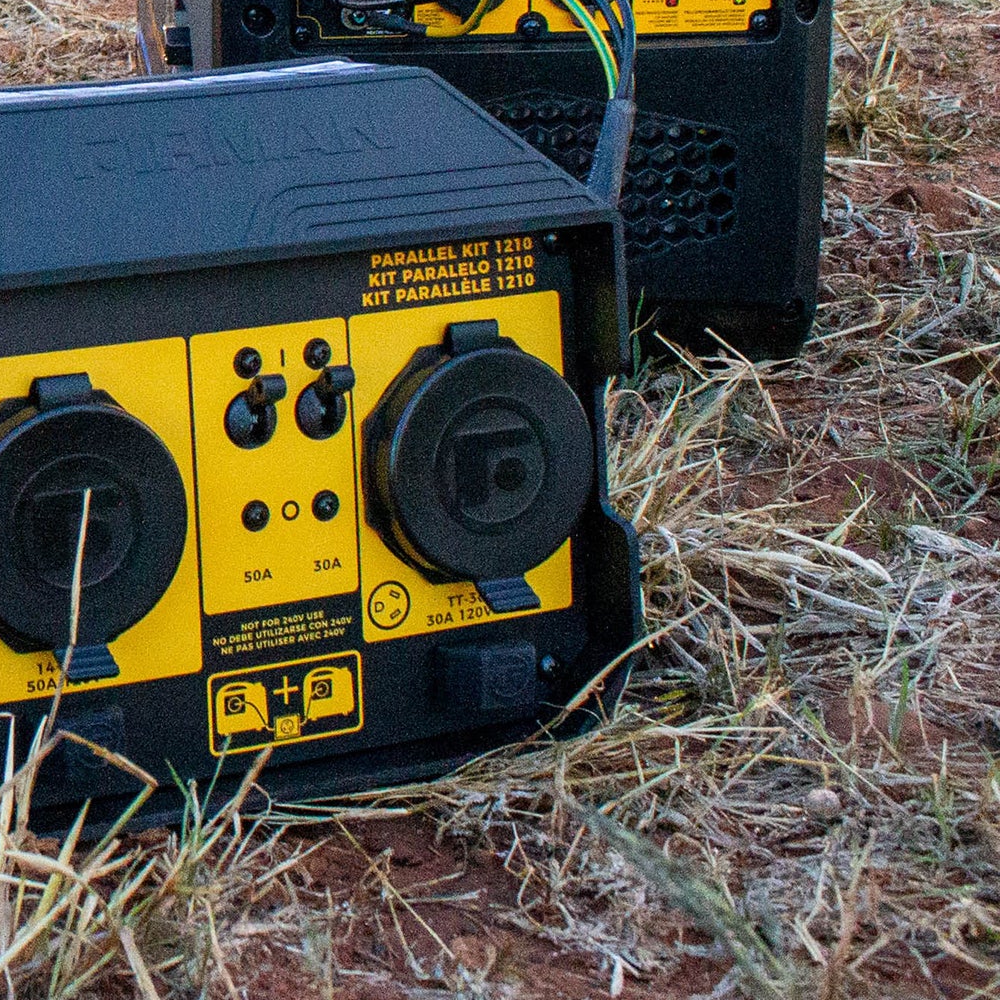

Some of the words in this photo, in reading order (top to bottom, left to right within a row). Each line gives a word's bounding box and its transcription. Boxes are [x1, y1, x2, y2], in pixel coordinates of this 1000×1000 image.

[371, 246, 457, 269] PARALLEL
[462, 241, 489, 258] KIT
[495, 237, 533, 254] 1210
[369, 271, 397, 288] KIT
[402, 260, 490, 284] PARALELO
[496, 255, 534, 272] 1210
[362, 290, 390, 307] KIT
[396, 277, 491, 303] PARALLÈLE
[497, 273, 535, 290] 1210
[244, 568, 273, 583] 50A
[313, 557, 342, 572] 30A
[212, 637, 227, 647] NO
[229, 632, 253, 644] DEBE
[255, 623, 307, 639] UTILIZARSE
[308, 620, 328, 630] CON
[330, 616, 353, 626] 240V
[241, 621, 259, 631] NOT
[262, 618, 280, 627] FOR
[283, 615, 305, 625] 240V
[306, 610, 324, 620] USE
[426, 612, 454, 627] 30A
[221, 645, 233, 655] NE
[236, 641, 254, 652] PAS
[255, 636, 295, 650] UTILISER
[298, 631, 321, 642] AVEC
[323, 628, 346, 638] 240V
[26, 678, 57, 693] 50A
